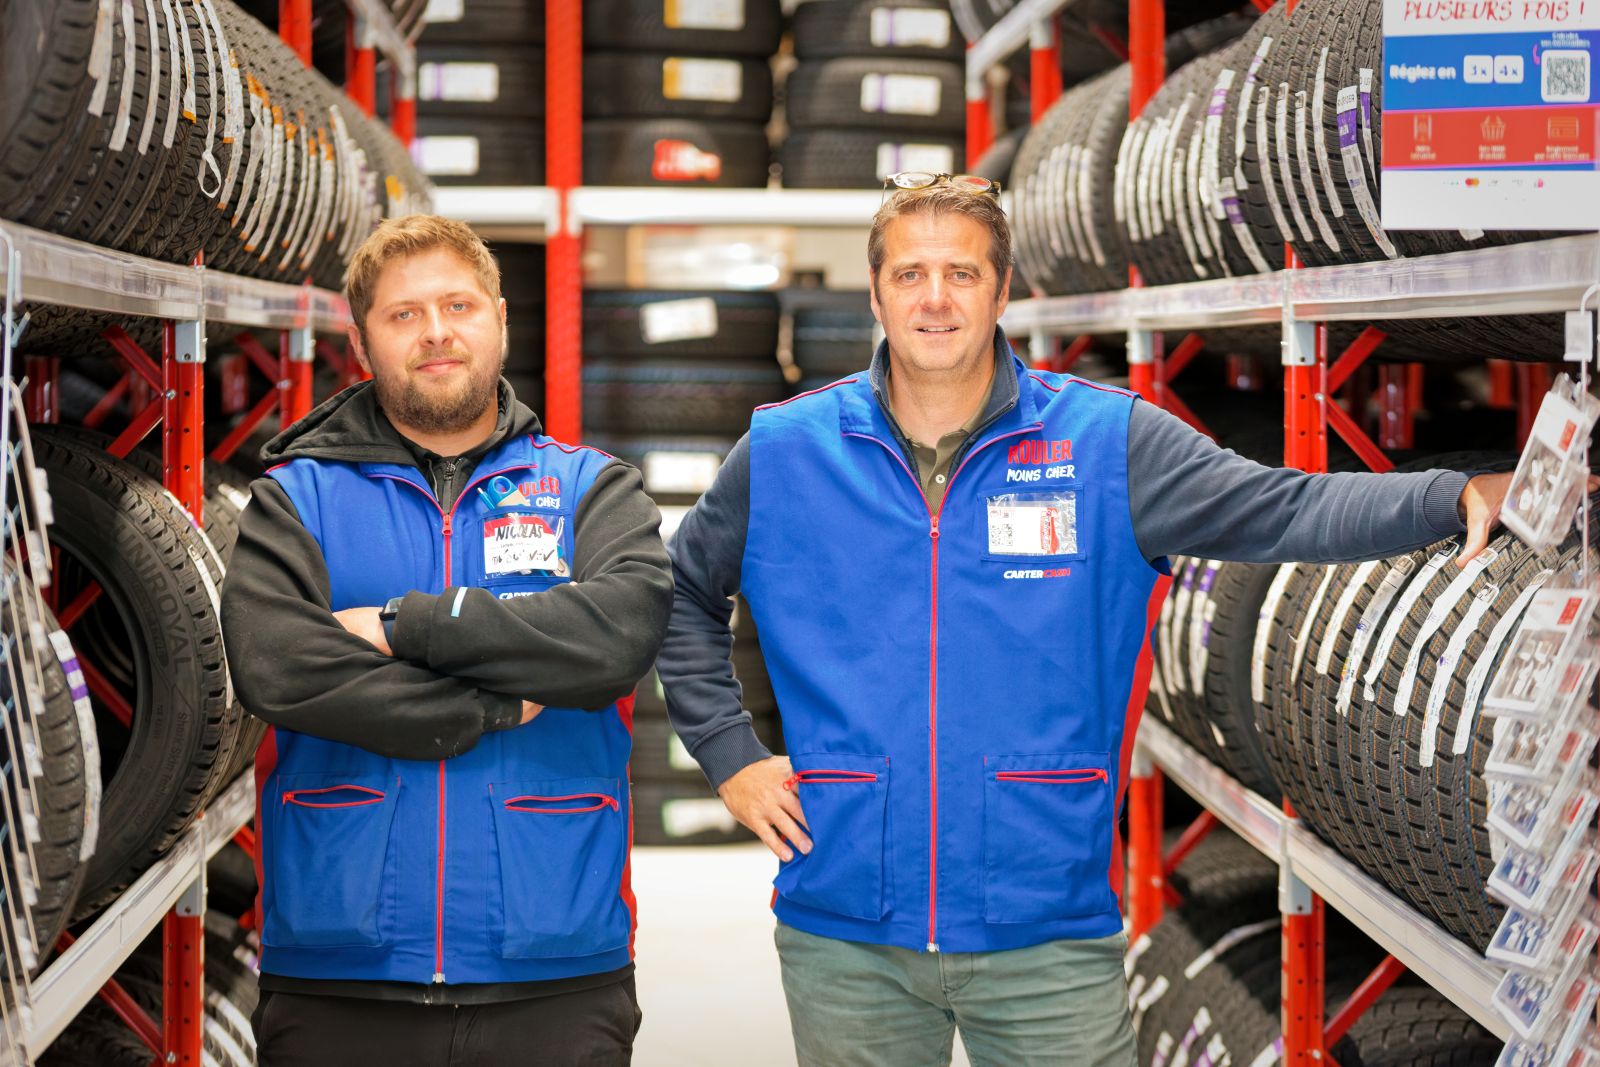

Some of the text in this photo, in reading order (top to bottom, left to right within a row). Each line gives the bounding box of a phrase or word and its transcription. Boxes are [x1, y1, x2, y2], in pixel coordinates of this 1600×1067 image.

[1403, 0, 1512, 21] PLUSIEURS
[1523, 0, 1569, 21] FOIS
[1389, 63, 1436, 83] Réglez
[1437, 66, 1456, 79] en
[1008, 439, 1073, 464] ROULER
[1006, 464, 1075, 483] MOINS CHER
[517, 476, 560, 497] ULER
[496, 523, 543, 542] NICOLAS
[116, 522, 192, 675] UNIROYAL
